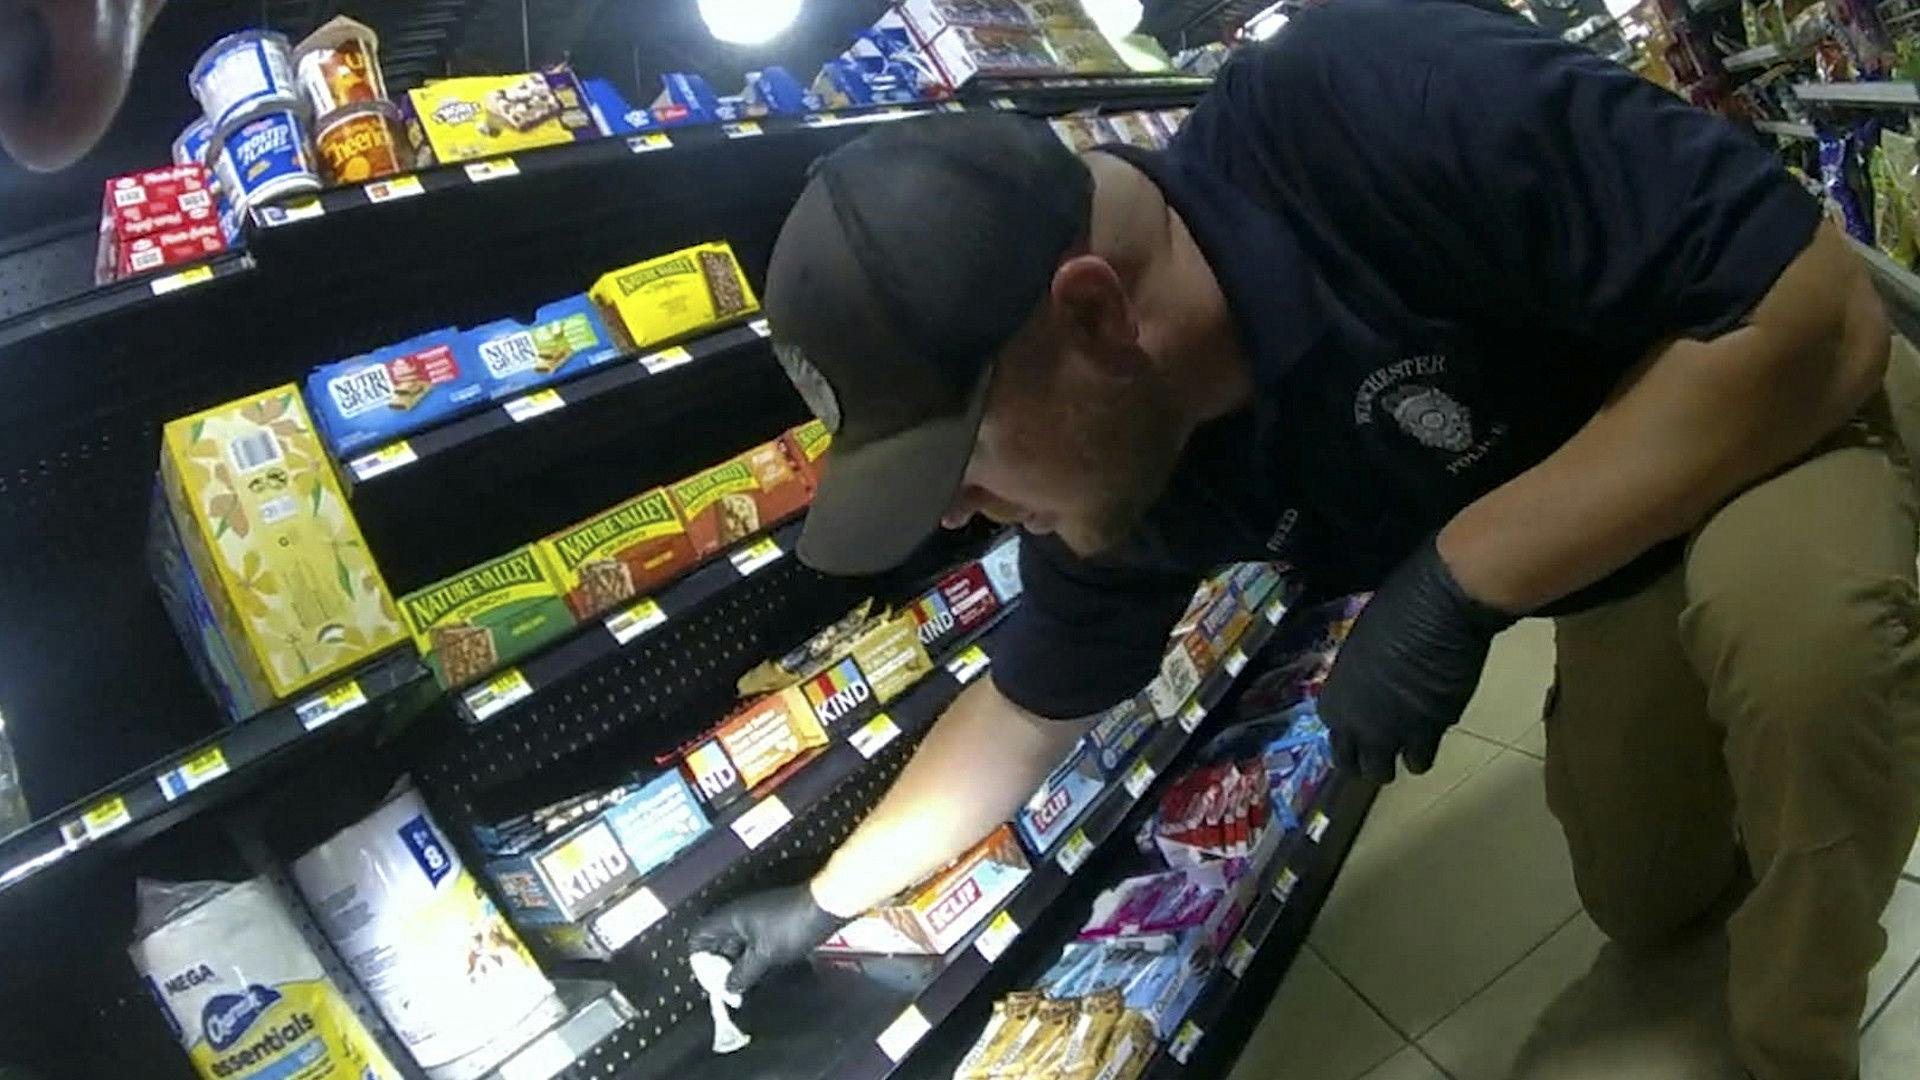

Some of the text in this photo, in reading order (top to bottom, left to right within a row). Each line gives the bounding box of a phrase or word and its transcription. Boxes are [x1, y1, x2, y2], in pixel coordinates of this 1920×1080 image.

[485, 335, 532, 362] NUTRI
[334, 369, 386, 395] NUTRI
[340, 380, 391, 410] GRAIN
[560, 518, 613, 565] NATURE
[611, 493, 667, 527] VALLEY
[411, 576, 475, 632] NATURE
[474, 554, 535, 587] VALLEY
[815, 681, 870, 726] KIND
[560, 852, 628, 903] KIND
[938, 879, 980, 925] CLIF
[164, 963, 216, 996] MEGA
[211, 1010, 316, 1078] essentials
